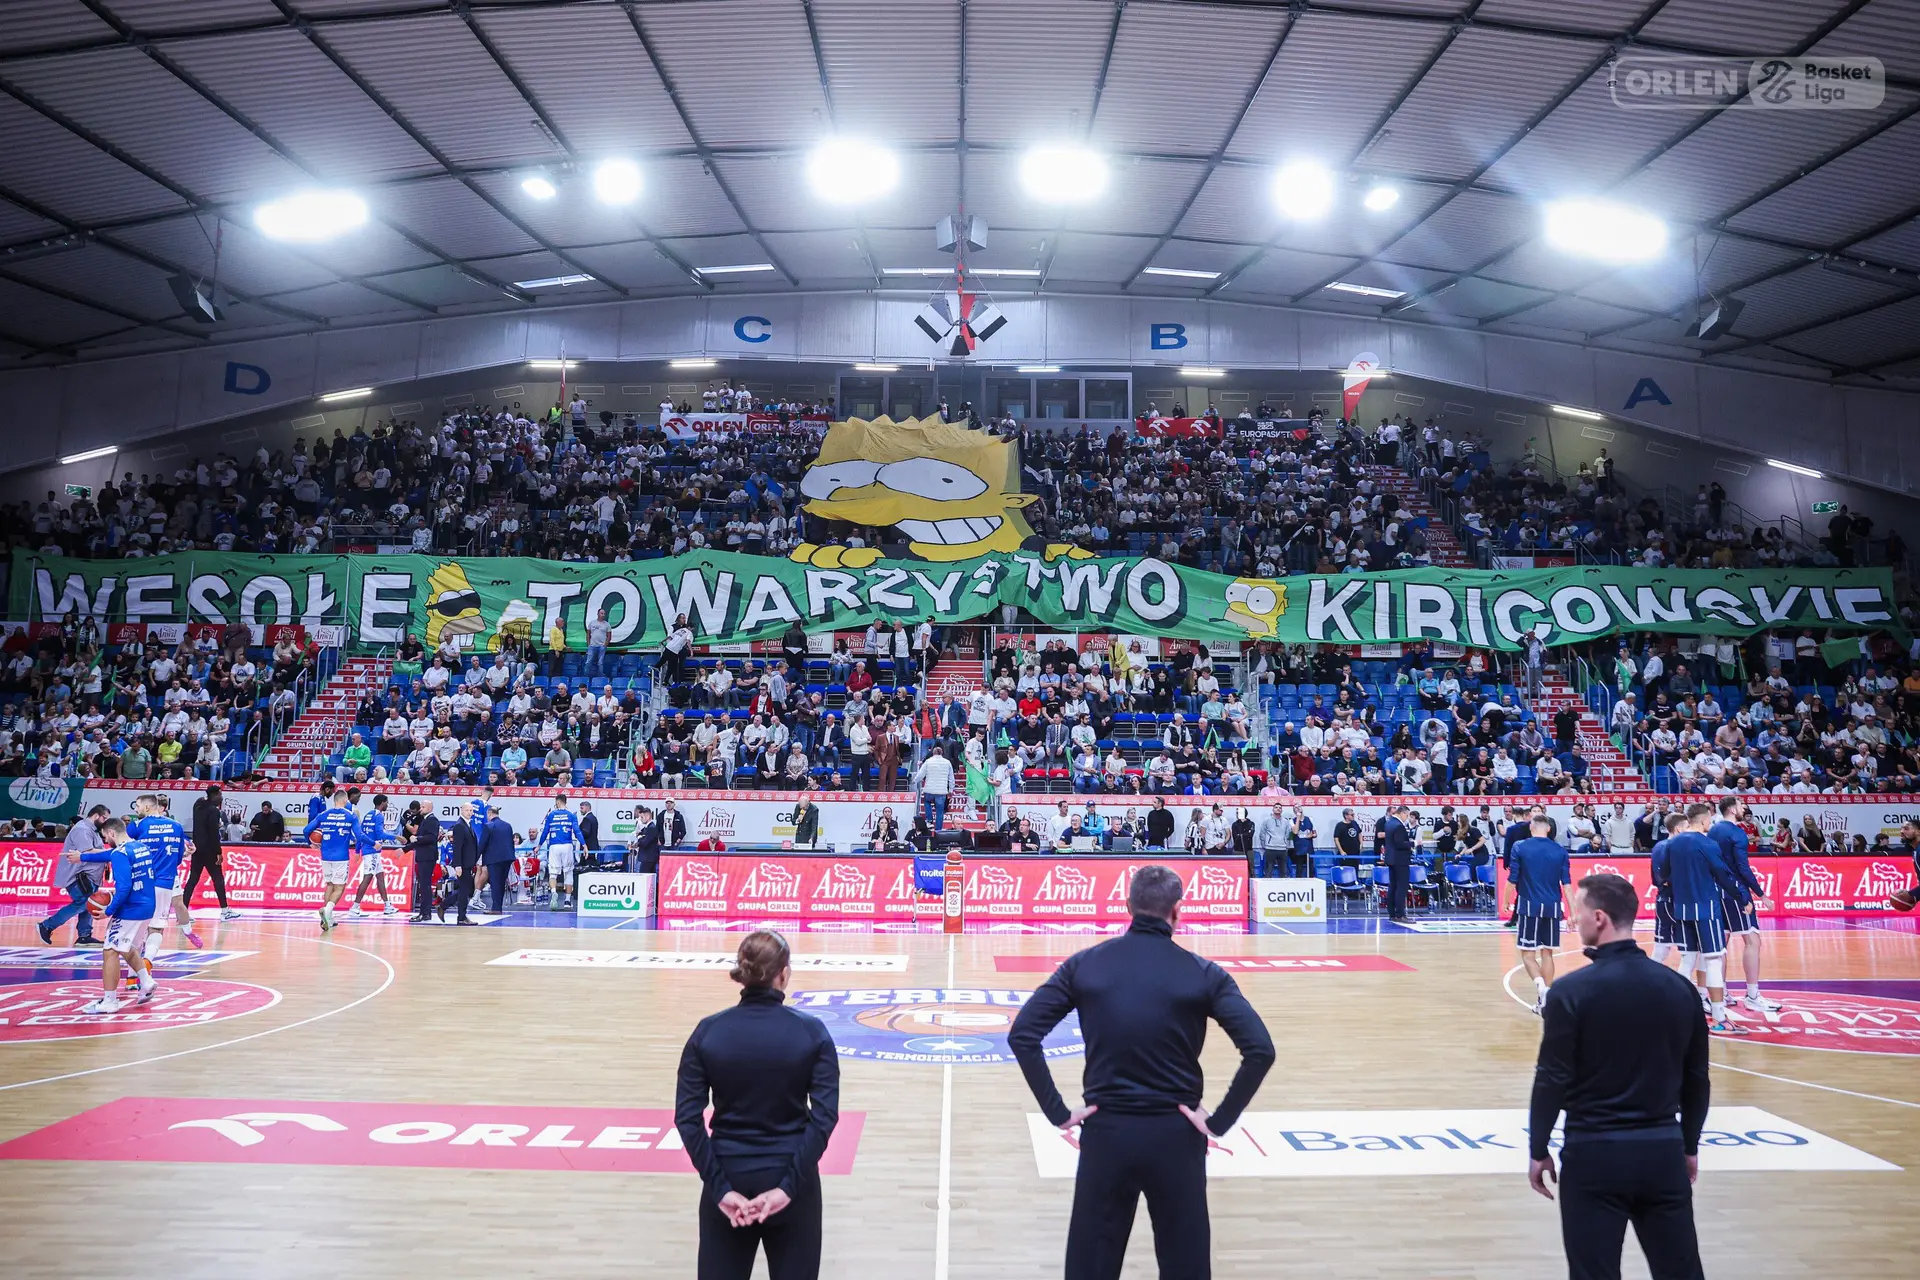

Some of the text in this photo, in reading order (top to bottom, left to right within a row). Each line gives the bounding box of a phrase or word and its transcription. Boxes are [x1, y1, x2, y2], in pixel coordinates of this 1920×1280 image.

[734, 316, 773, 343] C
[1150, 323, 1188, 350] B
[224, 361, 272, 395] D
[1623, 377, 1672, 410] A
[1322, 408, 1329, 416] B
[692, 420, 743, 433] ORLEN
[35, 567, 412, 643] WESOŁE
[526, 553, 1182, 647] TOWARZYSTWO
[313, 627, 335, 640] Anwil
[807, 636, 824, 647] nwil
[1209, 640, 1231, 650] Anwil
[698, 808, 736, 828] Anwil
[1817, 812, 1848, 831] Anwil
[0, 852, 53, 883] Anwil
[920, 869, 944, 877] molte
[664, 862, 728, 897] Anwil
[737, 863, 800, 899] Anwil
[811, 864, 875, 899] Anwil
[963, 868, 1023, 900] Anwil
[1033, 866, 1096, 900] Anwil
[1181, 866, 1242, 900] Anwil
[1783, 866, 1843, 897] Anwil
[19, 887, 48, 896] ORLEN
[233, 891, 262, 900] ORLEN
[274, 892, 302, 900] GRUPA
[588, 881, 635, 896] canvil
[1267, 888, 1315, 903] canvil
[664, 900, 725, 910] GRUPA ORLEN
[737, 901, 799, 911] GRUPA ORLEN
[811, 902, 874, 912] GRUPA ORLEN
[1033, 905, 1063, 913] GRUPA
[1180, 905, 1210, 914] GRUPA
[1783, 901, 1842, 910] GRUPA ORLEN
[1853, 901, 1881, 910] GRUPA
[875, 1051, 1003, 1063] TERMOIZOLACJA
[1279, 1127, 1520, 1152] Bank
